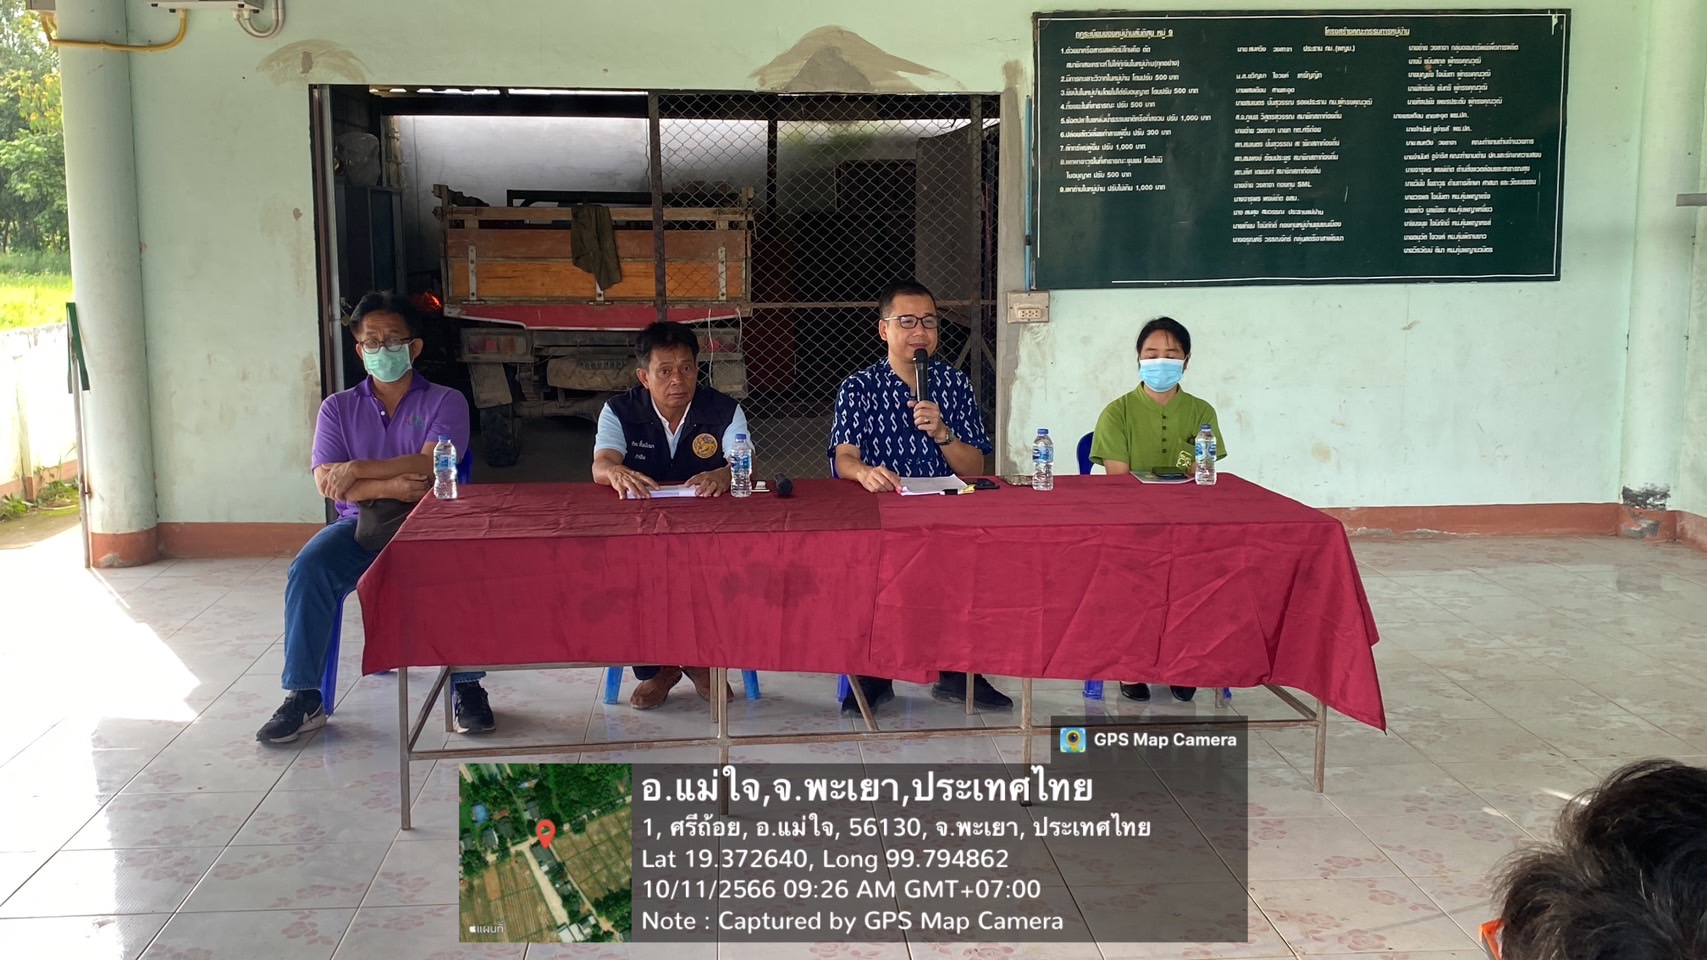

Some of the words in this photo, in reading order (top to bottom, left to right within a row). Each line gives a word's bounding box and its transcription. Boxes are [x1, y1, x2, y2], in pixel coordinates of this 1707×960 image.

[1116, 100, 1128, 108] ปรับ
[1166, 114, 1178, 122] ปรับ
[1132, 128, 1144, 136] ปรับ
[1093, 170, 1105, 178] ปรับ
